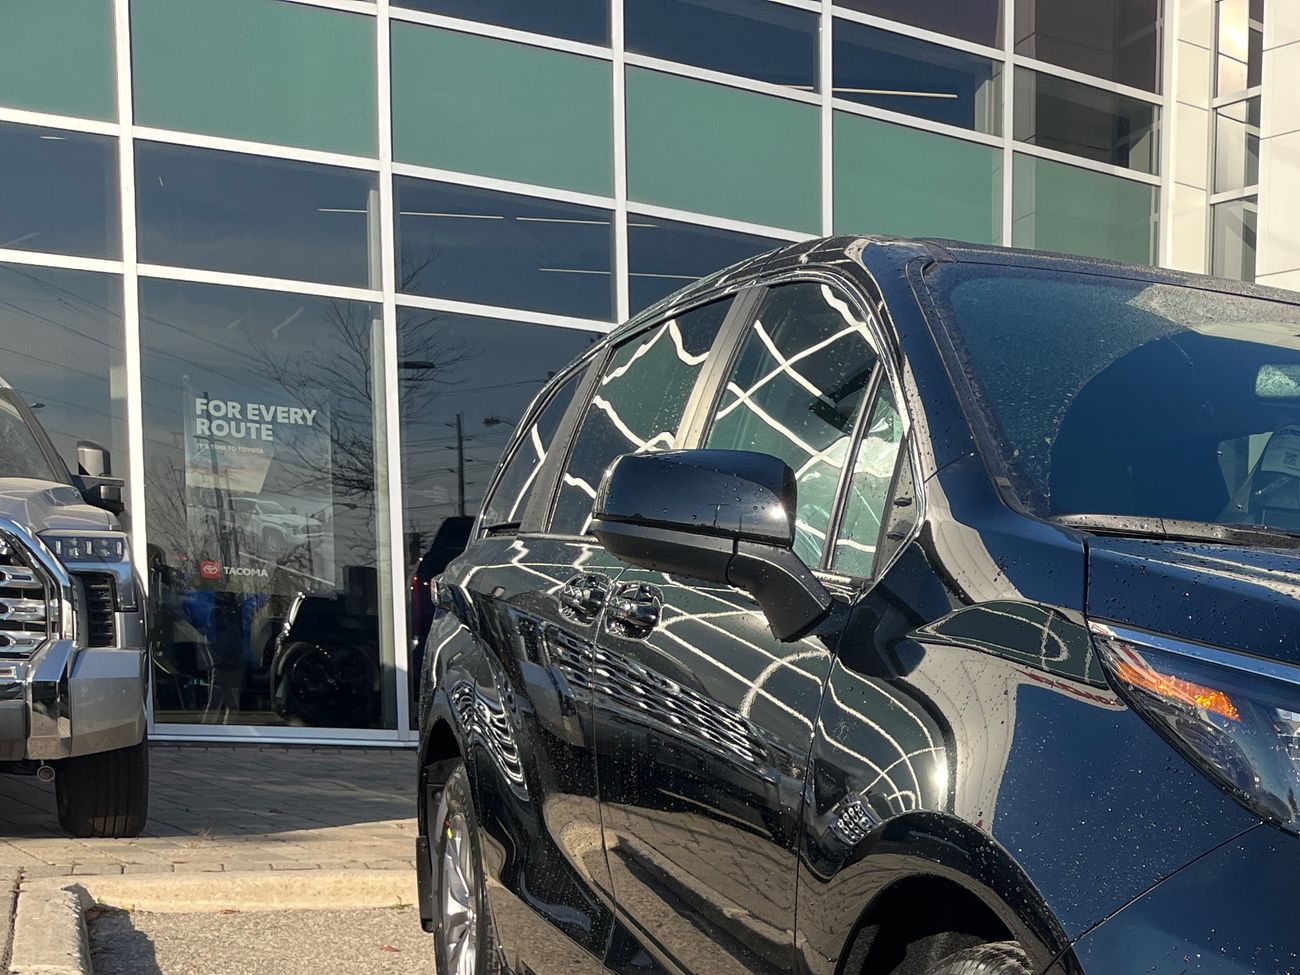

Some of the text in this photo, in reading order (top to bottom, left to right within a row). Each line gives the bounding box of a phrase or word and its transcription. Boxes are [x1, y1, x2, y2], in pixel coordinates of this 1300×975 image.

[195, 398, 317, 426] FOR EVERY
[196, 417, 274, 441] ROUTE
[223, 566, 268, 577] TACOMA
